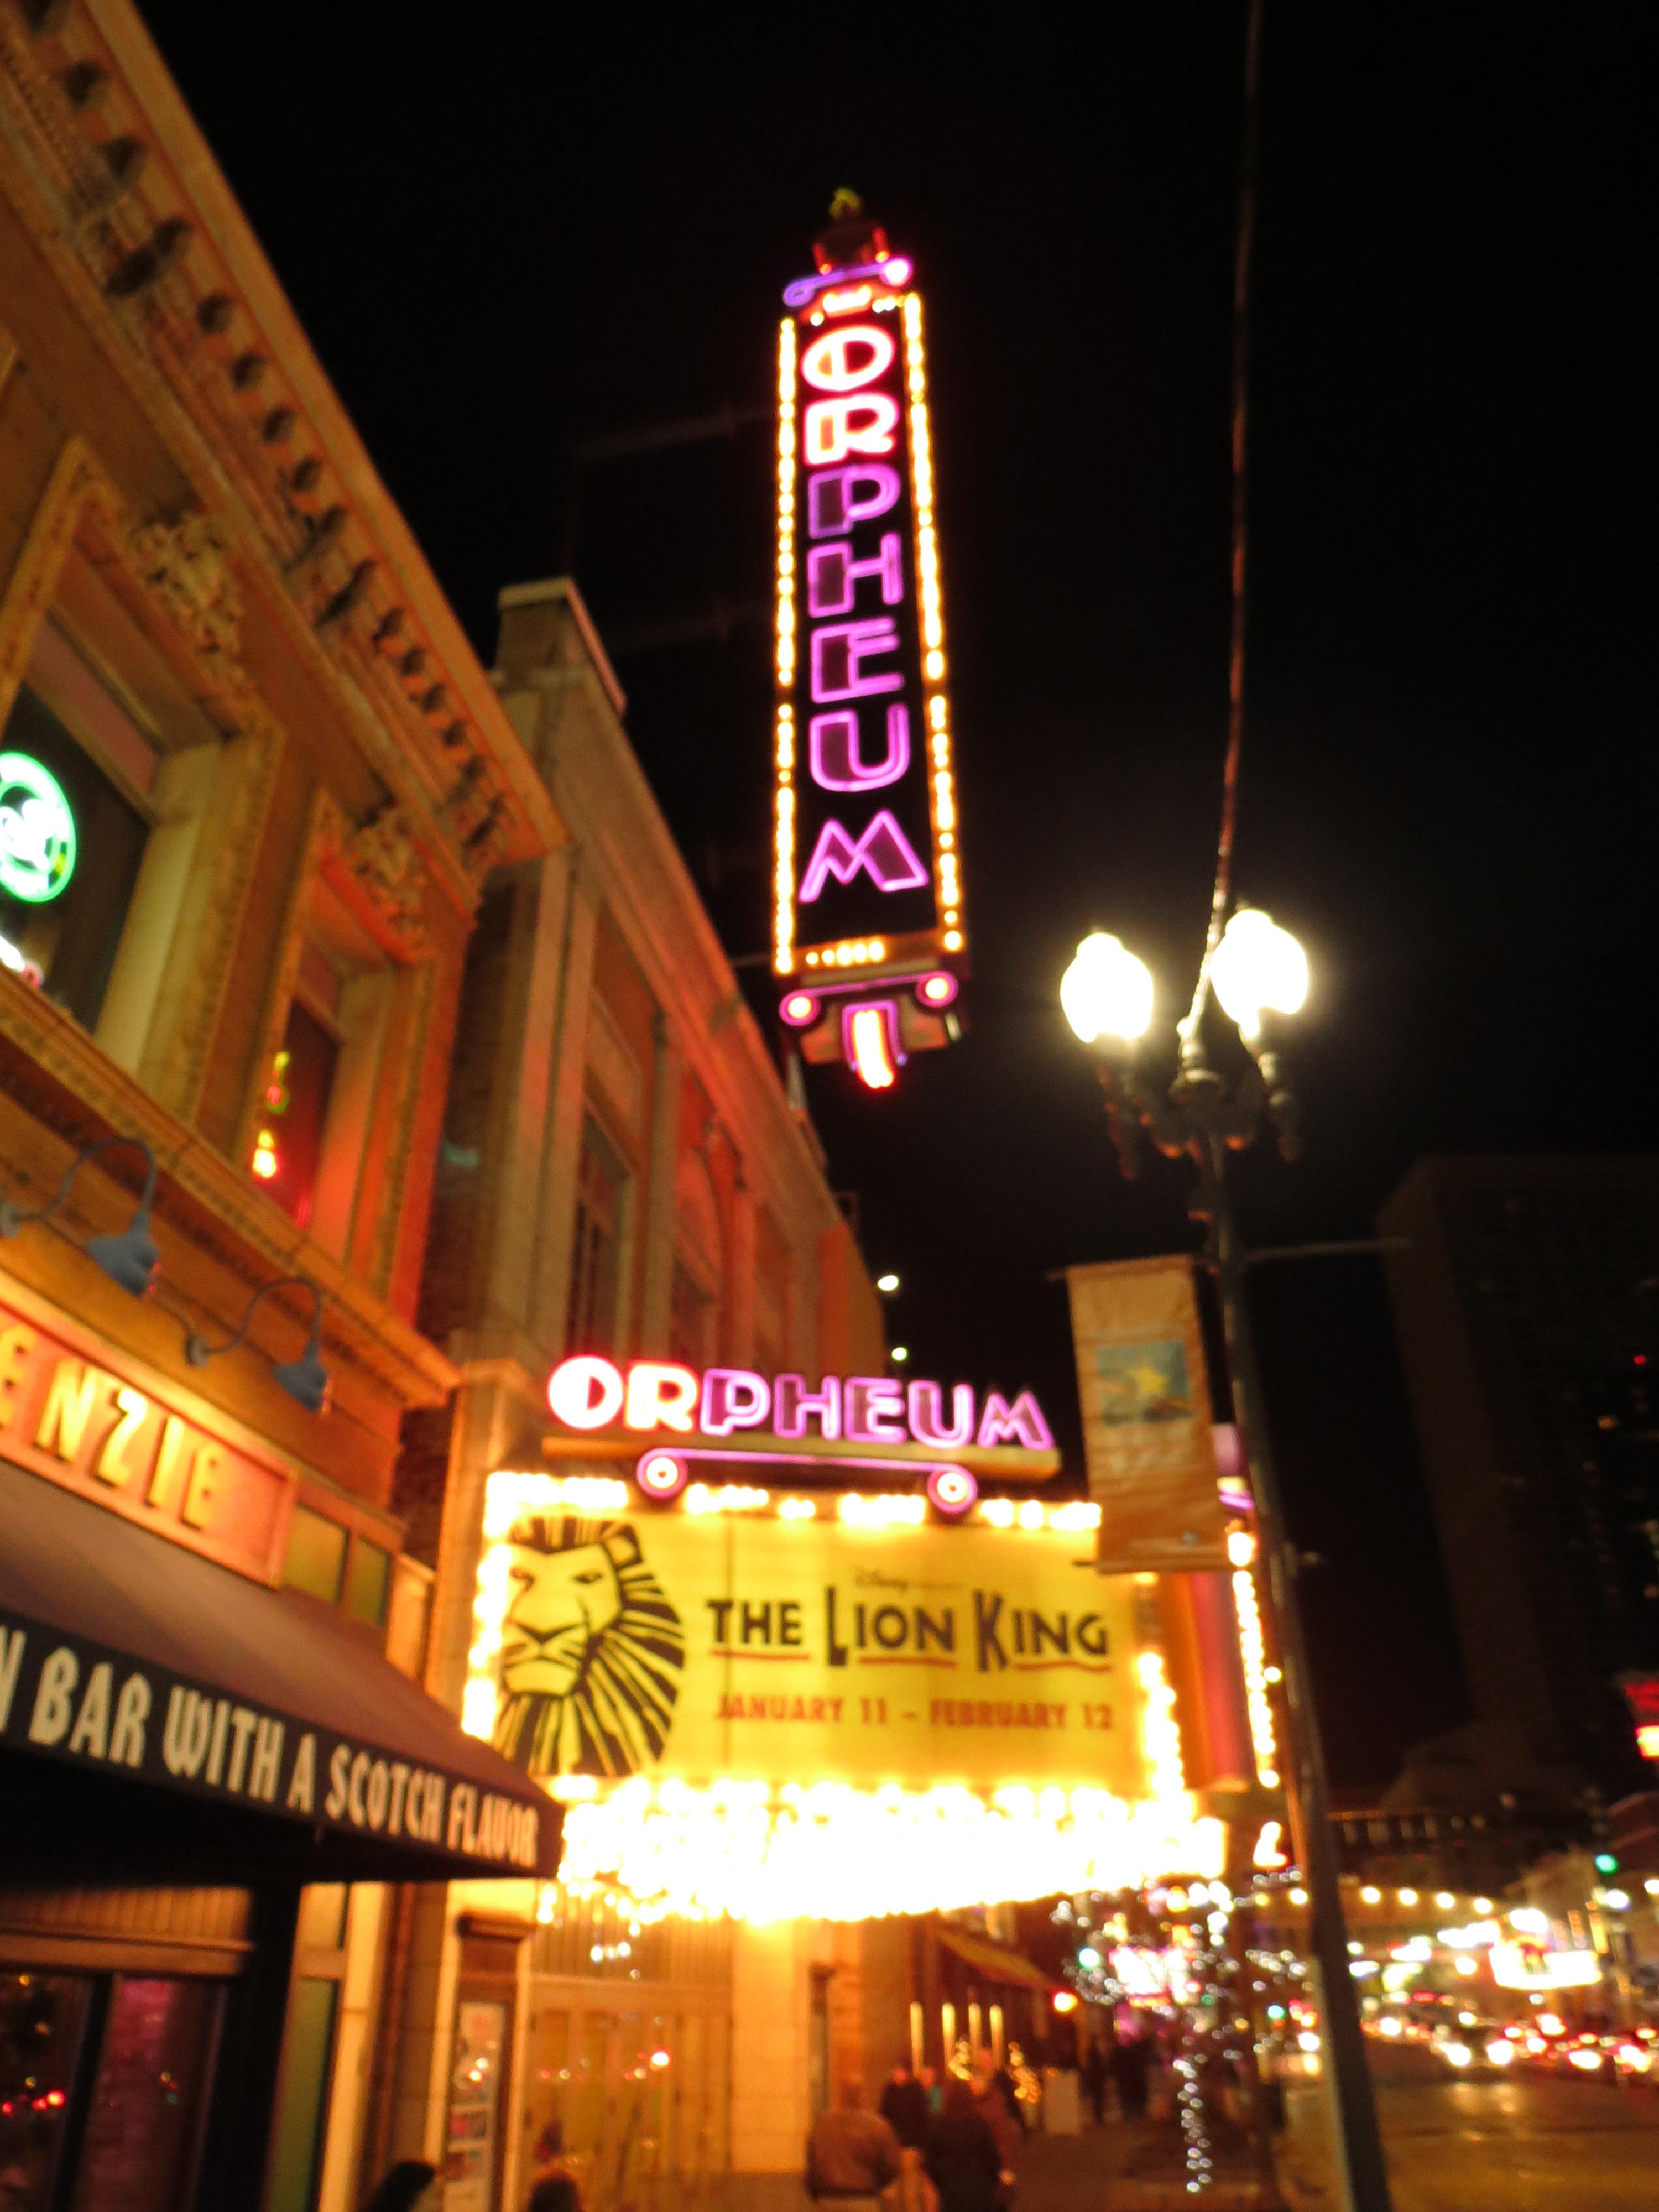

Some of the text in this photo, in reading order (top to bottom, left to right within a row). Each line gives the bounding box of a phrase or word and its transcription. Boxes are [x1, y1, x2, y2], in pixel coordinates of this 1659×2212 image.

[800, 325, 928, 904] ORPHEUM
[547, 1355, 1055, 1450] ORPHEUM
[707, 1585, 1109, 1673] THE LION KING
[29, 1646, 152, 1768] BAR
[163, 1684, 285, 1803] WITH
[286, 1732, 317, 1814] A
[325, 1742, 445, 1844] SCOTCH
[446, 1782, 539, 1869] FLAVOR
[718, 1695, 844, 1723] JANUARY
[860, 1697, 886, 1724] 11
[930, 1698, 1067, 1728] FEBRUARY
[1082, 1702, 1114, 1731] 12
